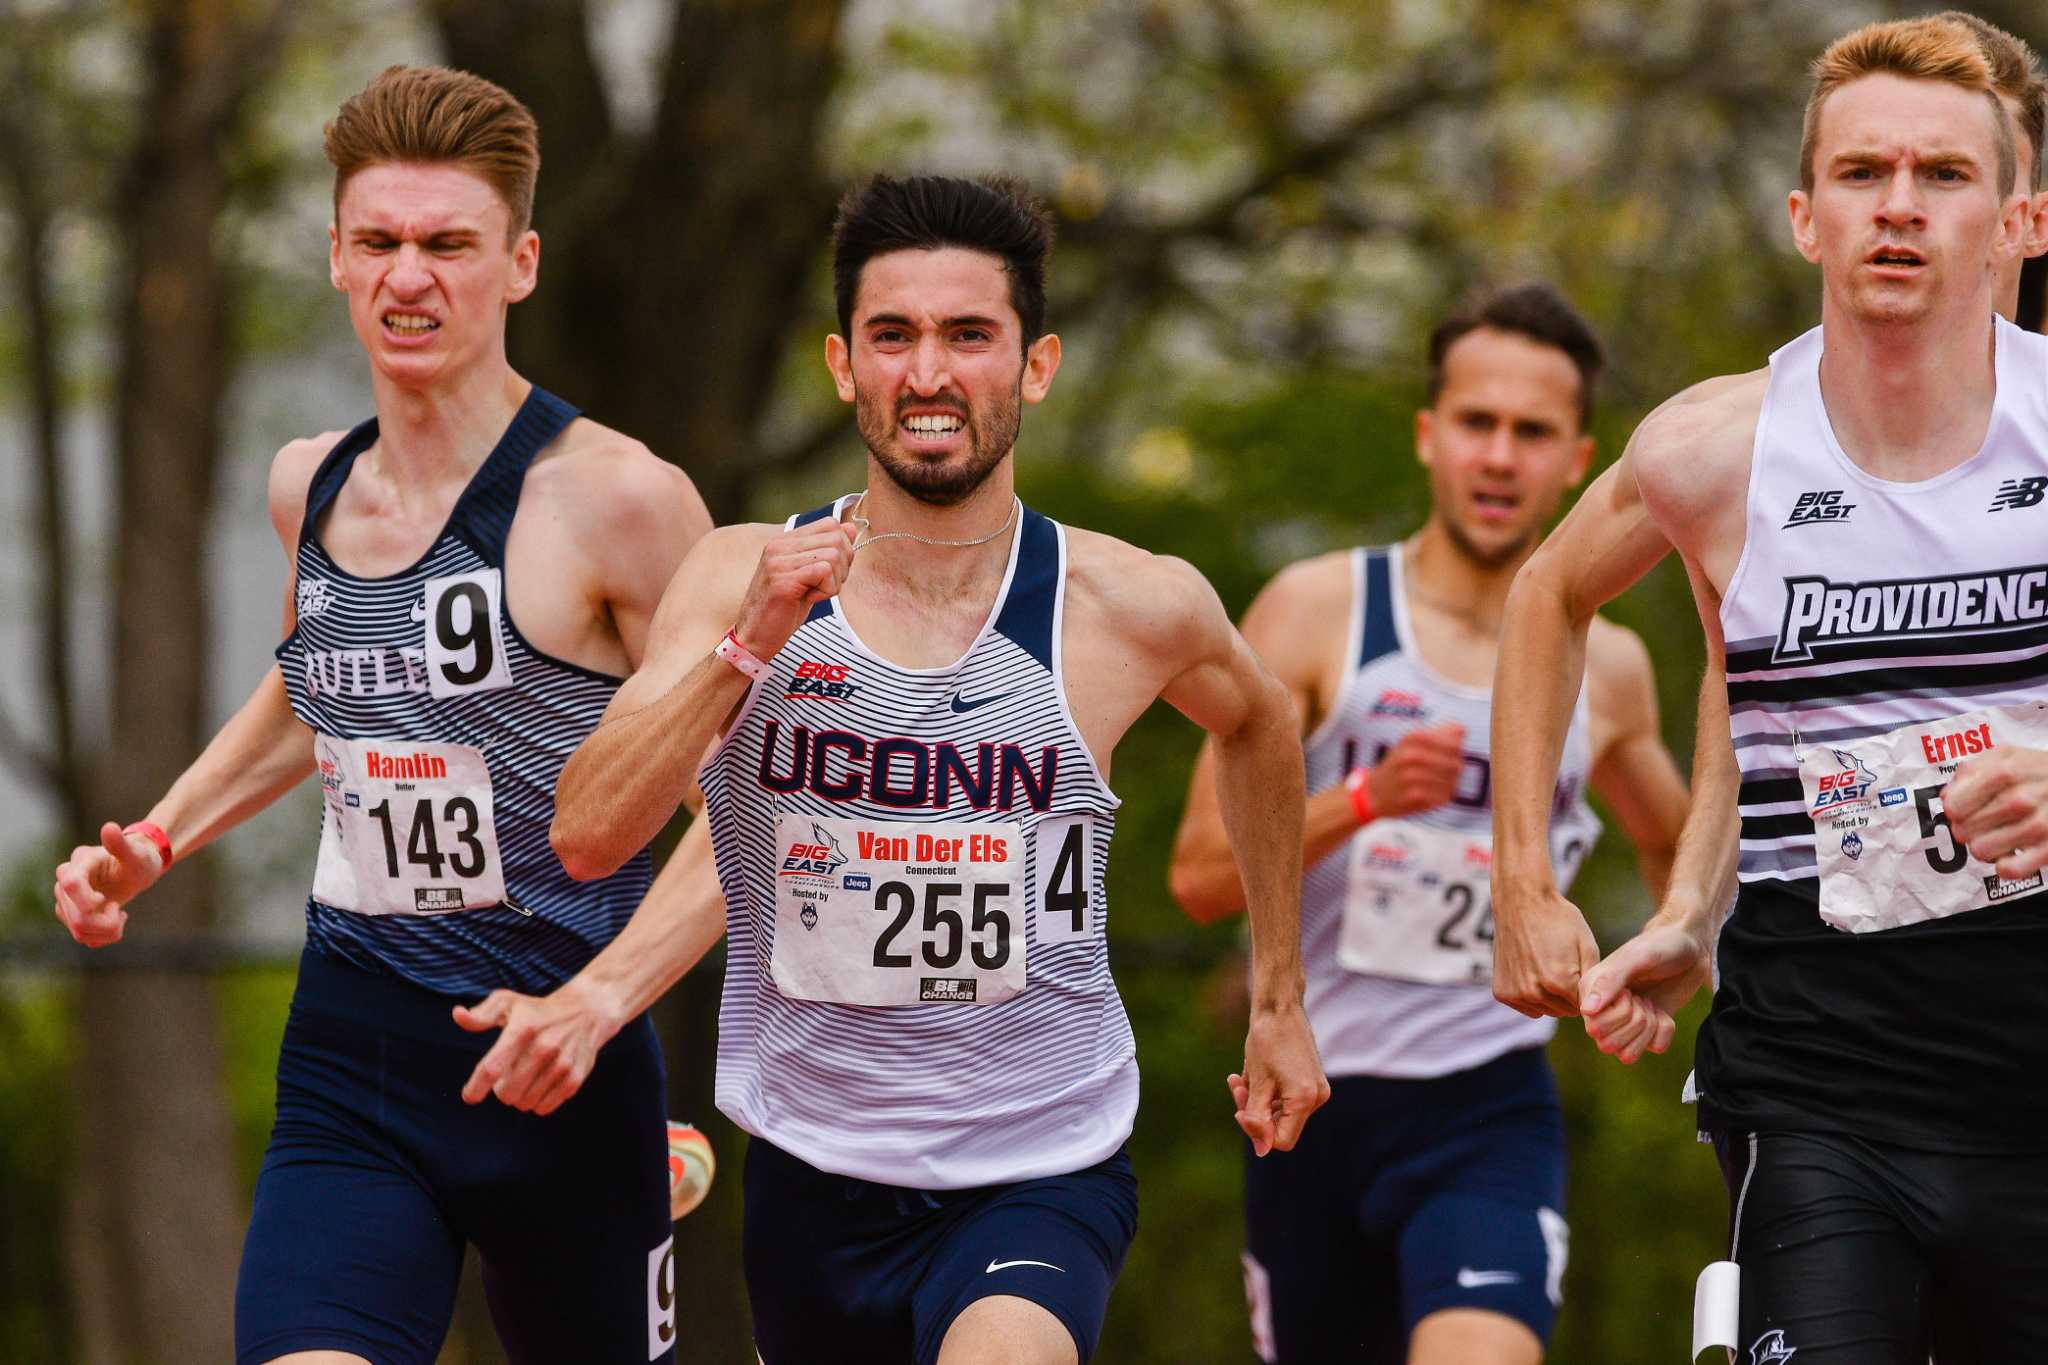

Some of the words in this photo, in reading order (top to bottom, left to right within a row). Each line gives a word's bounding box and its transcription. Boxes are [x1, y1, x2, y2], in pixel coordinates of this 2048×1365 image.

[1795, 490, 1844, 507] BIG
[1788, 504, 1857, 522] EAST
[1775, 566, 2048, 660] PROVIDENC
[435, 581, 493, 686] 9
[795, 661, 850, 682] BIG
[787, 677, 863, 699] EAST
[1920, 723, 1995, 764] Ernst
[366, 751, 447, 779] Hamlin
[758, 720, 1059, 813] UCONN
[1819, 769, 1856, 792] BIG
[1814, 783, 1871, 807] EAST
[1881, 792, 1905, 804] Jeep
[1858, 816, 1870, 826] by
[368, 796, 486, 879] 143
[857, 831, 909, 861] Van
[916, 833, 964, 862] Der
[969, 834, 1009, 863] Els
[788, 843, 832, 861] BIG
[782, 857, 841, 875] EAST
[905, 865, 957, 876] Connecticut
[846, 878, 868, 889] Jeep
[1044, 823, 1089, 932] 4
[1990, 876, 2041, 898] CHANGE
[417, 900, 462, 910] CHANGE
[792, 888, 818, 900] Hosted
[819, 889, 829, 902] by
[872, 880, 1010, 970] 255
[922, 991, 974, 1000] CHANGE
[934, 980, 960, 992] BE
